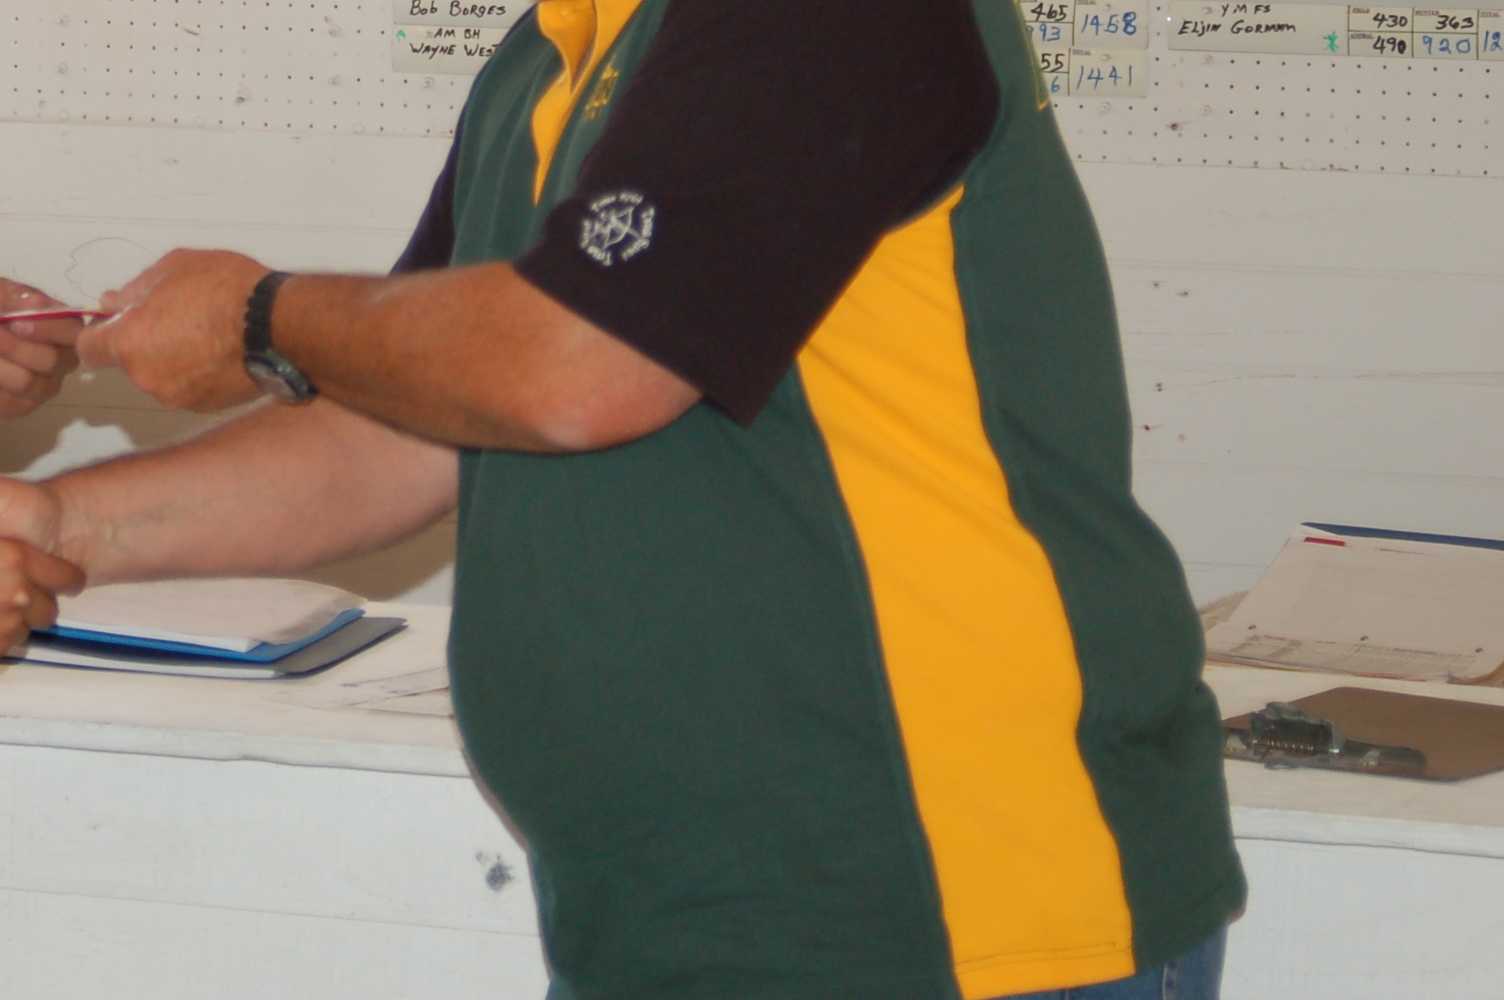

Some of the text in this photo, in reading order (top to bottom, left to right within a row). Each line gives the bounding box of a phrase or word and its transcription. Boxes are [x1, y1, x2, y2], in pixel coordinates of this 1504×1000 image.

[410, 0, 438, 16] Bob
[1030, 4, 1068, 21] 465
[1373, 13, 1407, 28] 430
[1422, 35, 1471, 54] 920
[1076, 65, 1132, 88] 1441
